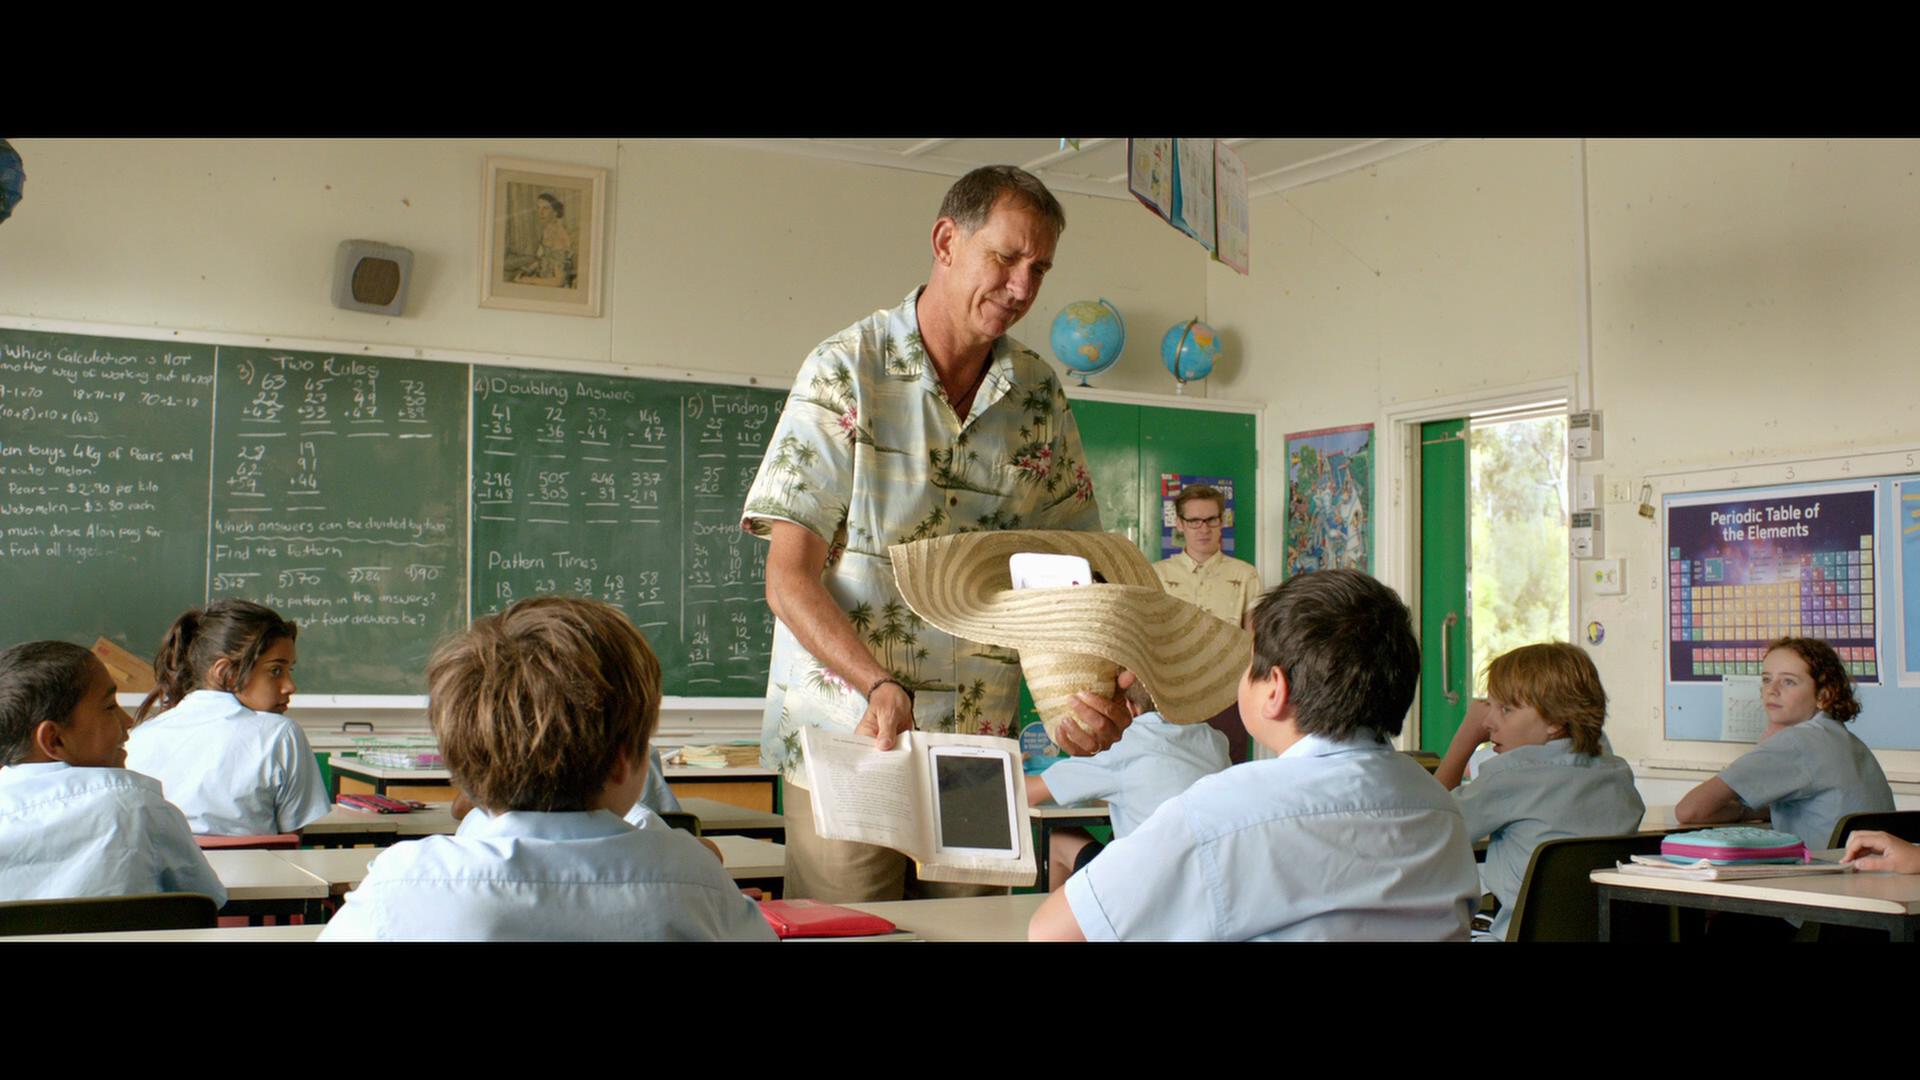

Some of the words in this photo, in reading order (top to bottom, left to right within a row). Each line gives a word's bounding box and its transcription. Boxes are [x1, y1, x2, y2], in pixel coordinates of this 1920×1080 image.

[272, 356, 314, 371] Two
[323, 357, 380, 379] Rules
[101, 369, 150, 384] working
[261, 373, 287, 390] 63
[304, 378, 334, 391] 45
[400, 380, 426, 395] 72
[491, 378, 569, 405] Doubling
[576, 382, 636, 403] Answers
[491, 403, 511, 421] 41
[545, 407, 566, 422] 72
[712, 394, 768, 423] Finding
[29, 444, 67, 465] buys
[108, 446, 123, 460] of
[130, 448, 163, 463] Pears
[171, 448, 193, 461] and
[482, 472, 512, 487] 296
[539, 471, 570, 488] 505
[591, 472, 615, 486] 246
[631, 471, 662, 487] 337
[703, 467, 725, 481] 35
[1785, 466, 1796, 480] 3
[1711, 505, 1763, 526] Periodic
[1765, 505, 1801, 523] Table
[1804, 502, 1820, 519] of
[8, 526, 45, 537] much
[86, 523, 115, 538] Alan
[215, 519, 254, 536] Which
[258, 520, 314, 533] answers
[318, 521, 342, 531] can
[347, 517, 363, 530] be
[367, 518, 407, 531] divided
[1722, 527, 1744, 541] the
[1747, 523, 1809, 541] Elements
[46, 543, 61, 557] all
[215, 544, 250, 561] Find
[255, 546, 278, 556] the
[488, 550, 545, 570] Pattern
[552, 551, 598, 571] Times
[604, 575, 624, 591] 48
[639, 571, 660, 586] 58
[497, 581, 512, 598] 18
[266, 593, 284, 607] the
[287, 594, 332, 608] pattern
[337, 596, 348, 605] in
[353, 592, 370, 603] the
[351, 614, 399, 626] answers
